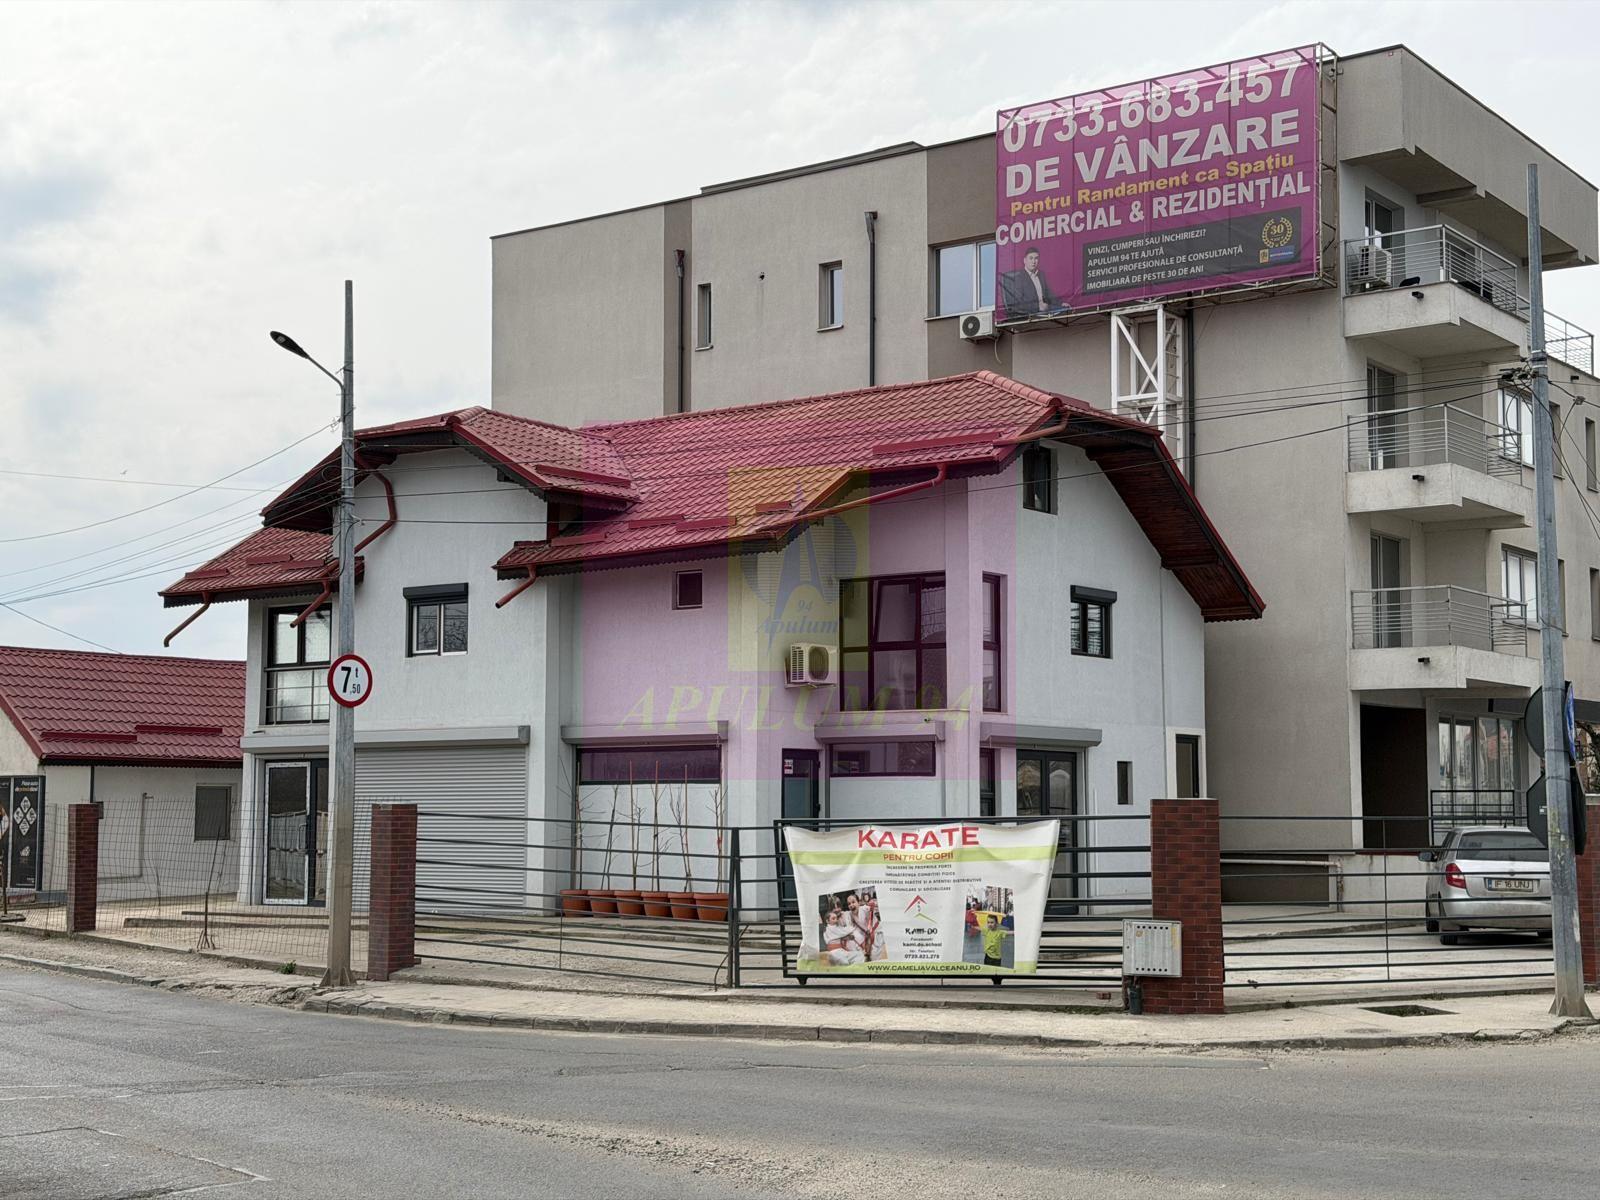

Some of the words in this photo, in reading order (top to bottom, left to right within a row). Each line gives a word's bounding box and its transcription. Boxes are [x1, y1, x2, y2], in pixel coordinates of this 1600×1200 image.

[1003, 56, 1301, 152] 0733.683.457
[1006, 157, 1060, 197] DE
[1075, 109, 1300, 183] VÂNZARE
[1011, 194, 1071, 216] Pentru
[1077, 168, 1189, 205] Randament
[1195, 168, 1219, 184] ca
[1226, 154, 1294, 178] Spațiu
[996, 205, 1121, 246] COMERCIAL
[1129, 201, 1144, 221] &
[1153, 171, 1310, 219] REZIDENȚIAL
[1088, 244, 1110, 256] VINZI,
[1111, 240, 1144, 252] CUMPERI
[1145, 236, 1160, 246] SAU
[1161, 228, 1206, 243] ÎNCHIRIEZI?
[1270, 224, 1284, 234] 30
[1088, 256, 1119, 267] APULUM
[1121, 254, 1129, 262] 94
[1131, 252, 1139, 260] TE
[1140, 247, 1164, 259] AJUTĂ
[1088, 267, 1117, 278] SERVICII
[1118, 257, 1175, 273] PROFESIONALE
[1176, 255, 1187, 263] DE
[1188, 245, 1243, 263] CONSULTANȚĂ
[1087, 276, 1130, 290] IMOBILIARĂ
[1132, 275, 1142, 283] DE
[1143, 271, 1166, 282] PESTE
[1167, 269, 1177, 277] 30
[1178, 268, 1188, 276] DE
[1190, 265, 1204, 274] ANI
[858, 827, 979, 849] KARATE
[883, 853, 923, 861] PENTRU
[925, 852, 954, 860] COPII
[1494, 880, 1502, 888] IF
[1505, 880, 1512, 888] 16
[1514, 880, 1530, 888] UNJ
